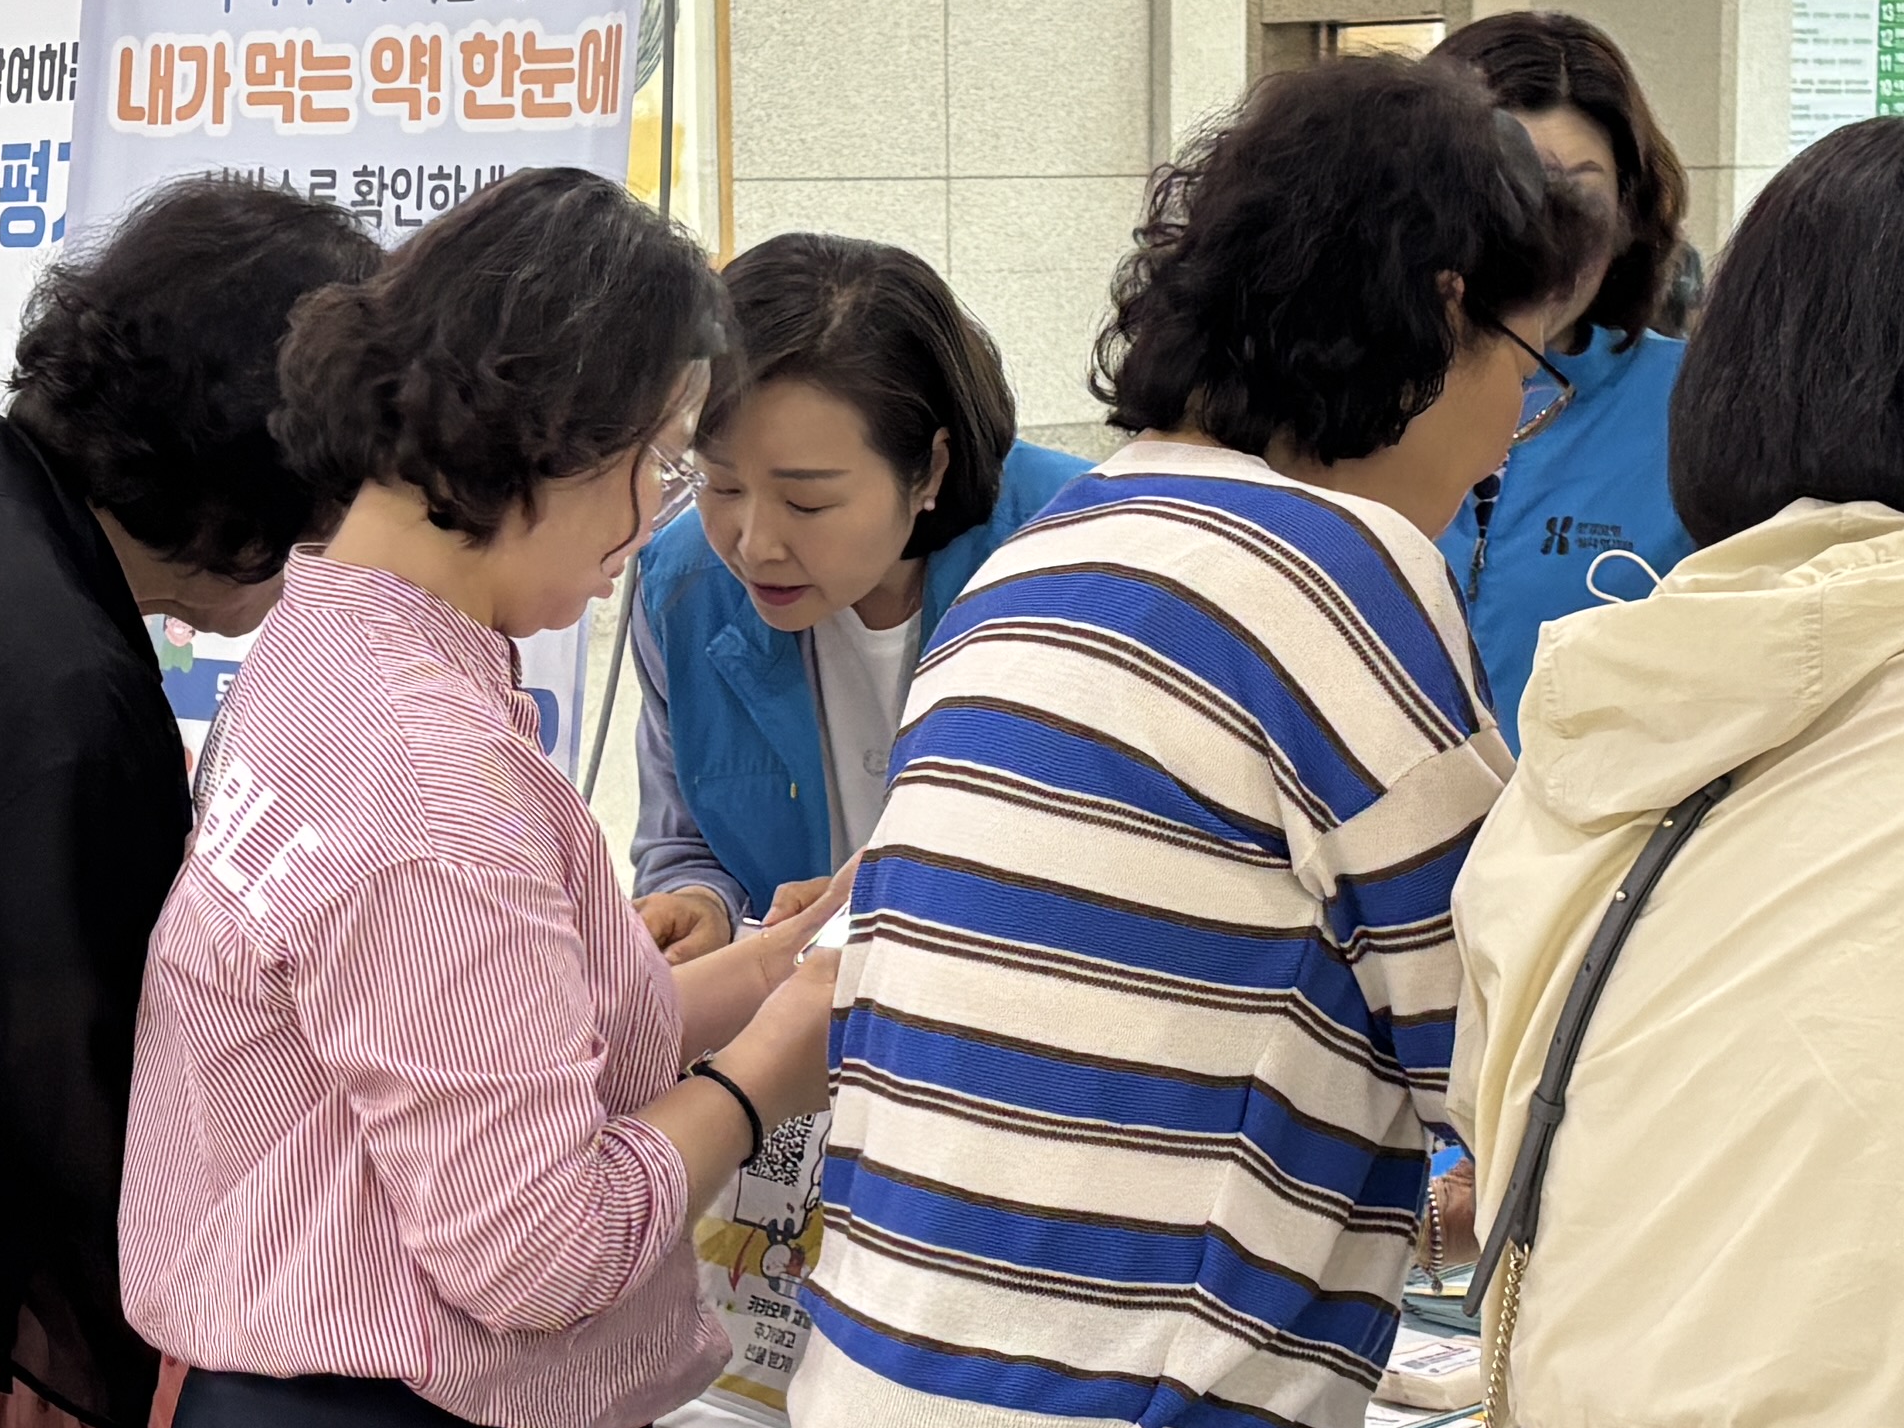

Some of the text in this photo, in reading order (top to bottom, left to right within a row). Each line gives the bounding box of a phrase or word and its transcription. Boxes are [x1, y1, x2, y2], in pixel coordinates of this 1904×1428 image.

[116, 22, 624, 126] 내가 먹는 약! 한눈에
